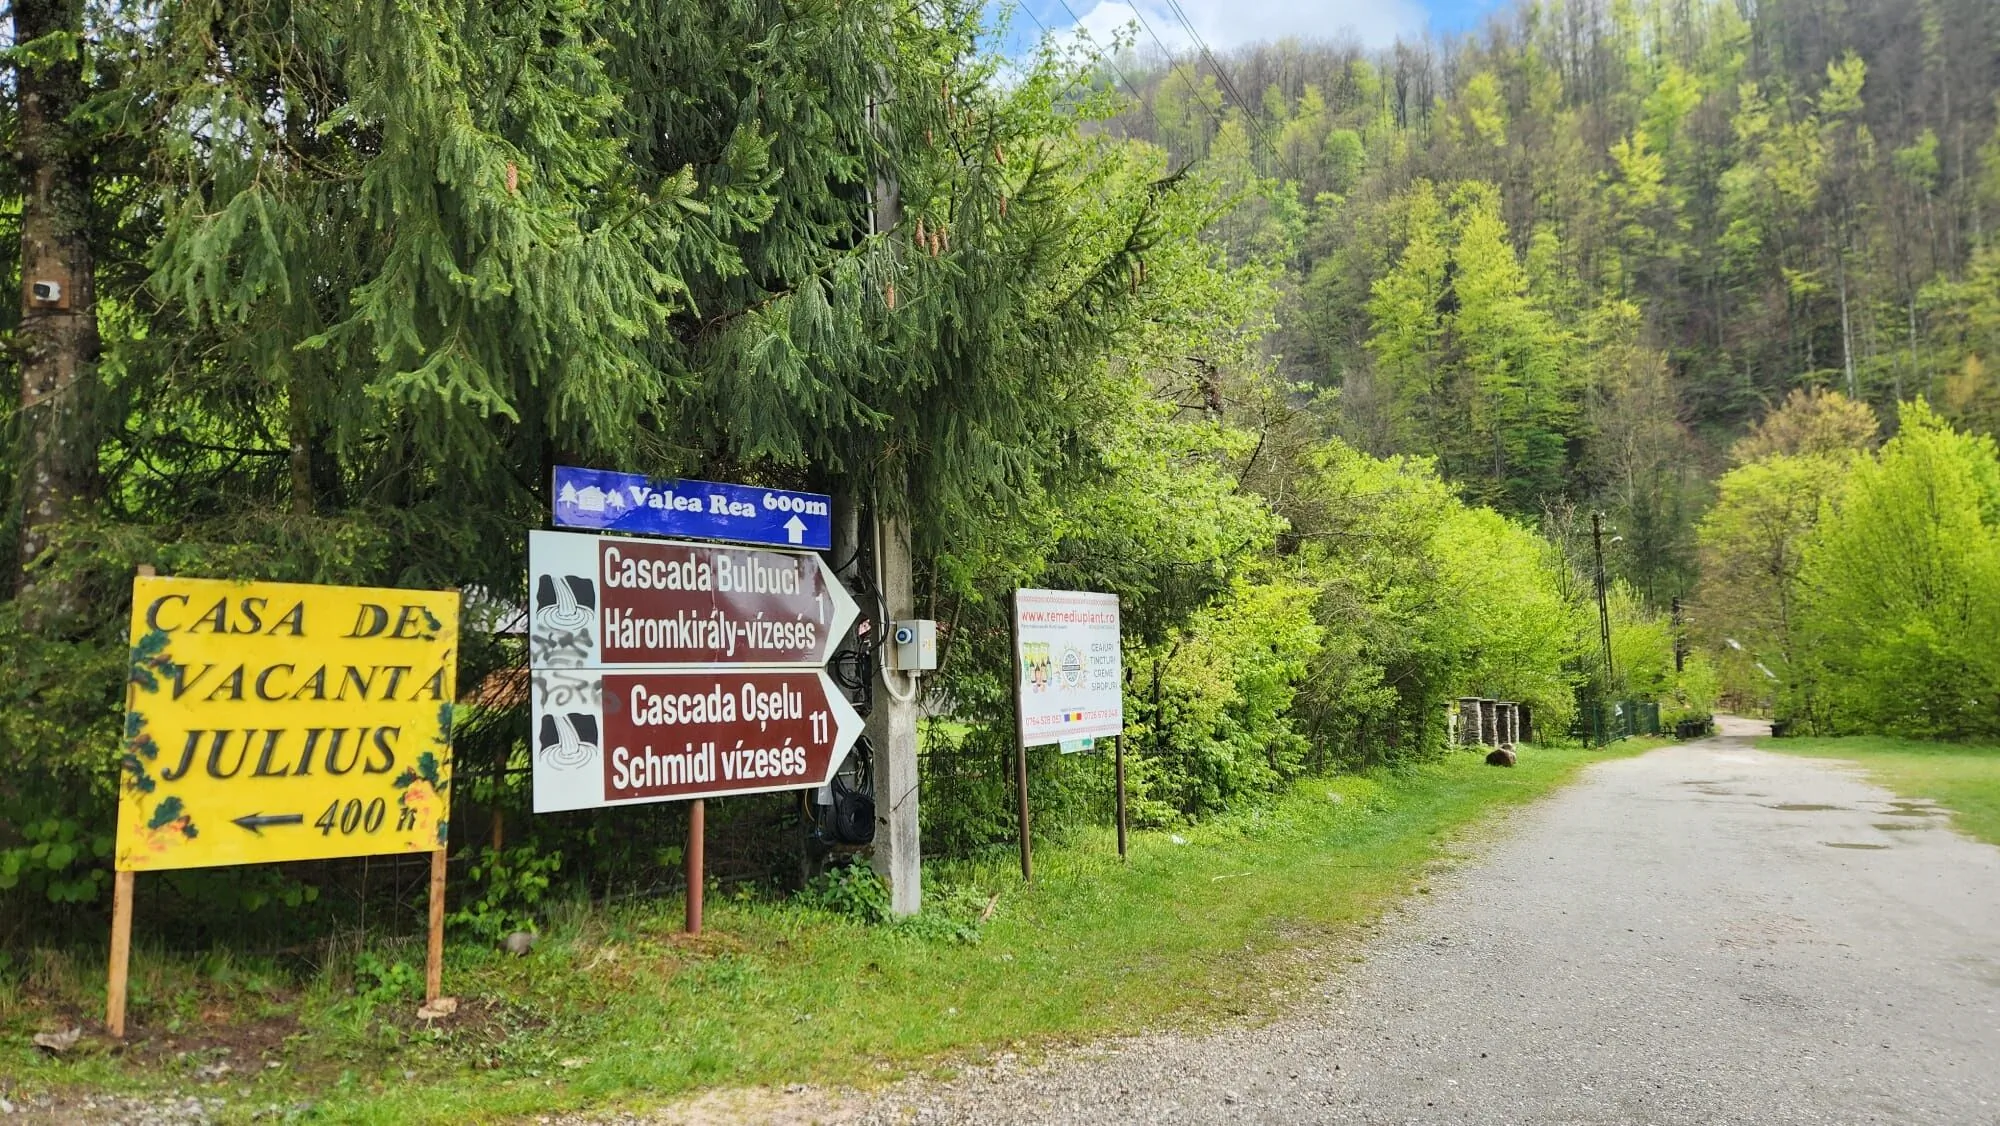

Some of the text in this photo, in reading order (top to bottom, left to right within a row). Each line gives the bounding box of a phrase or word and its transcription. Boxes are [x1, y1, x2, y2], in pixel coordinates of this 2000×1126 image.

[629, 485, 828, 517] Valea Rea 600m
[604, 546, 800, 595] Cascada Bulbuci
[146, 594, 428, 640] CASA DE
[604, 607, 816, 657] Háromkirály-vízesés
[815, 596, 825, 625] 1
[1021, 610, 1115, 624] www.remediuplant.ro
[630, 684, 737, 727] Cascada
[741, 682, 802, 732] Oșelu
[160, 725, 402, 781] JULIUS
[612, 737, 807, 790] Schmidl vízesés
[314, 797, 386, 837] 400
